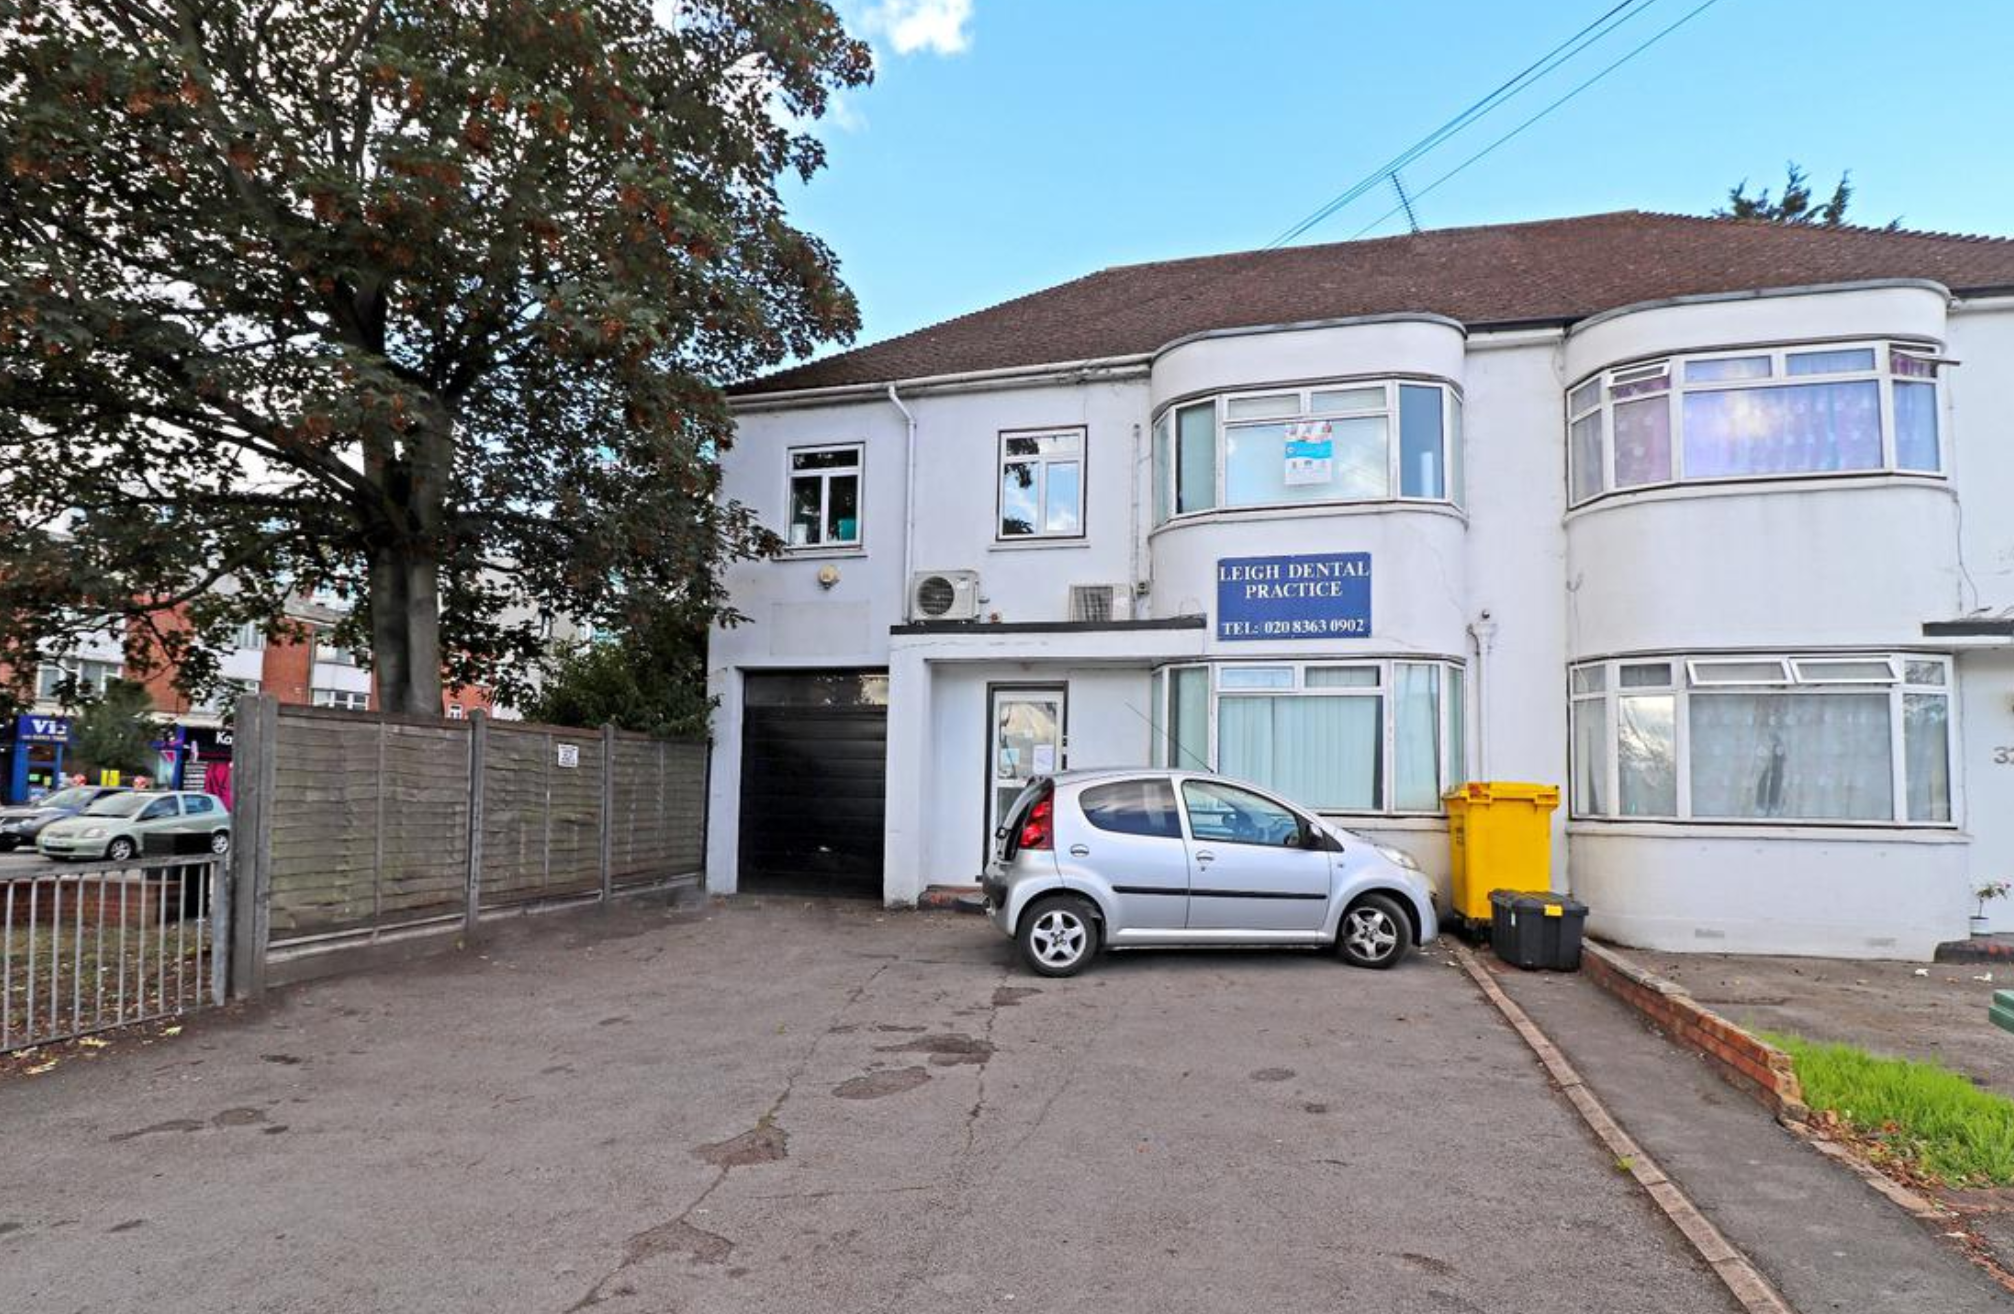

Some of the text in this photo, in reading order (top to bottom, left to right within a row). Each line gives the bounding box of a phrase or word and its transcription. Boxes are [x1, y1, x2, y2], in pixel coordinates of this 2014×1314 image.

[1220, 561, 1369, 580] LEIGH DENTAL
[1245, 581, 1343, 599] PRACTICE
[1221, 618, 1364, 635] TEL: 020 8363 0902
